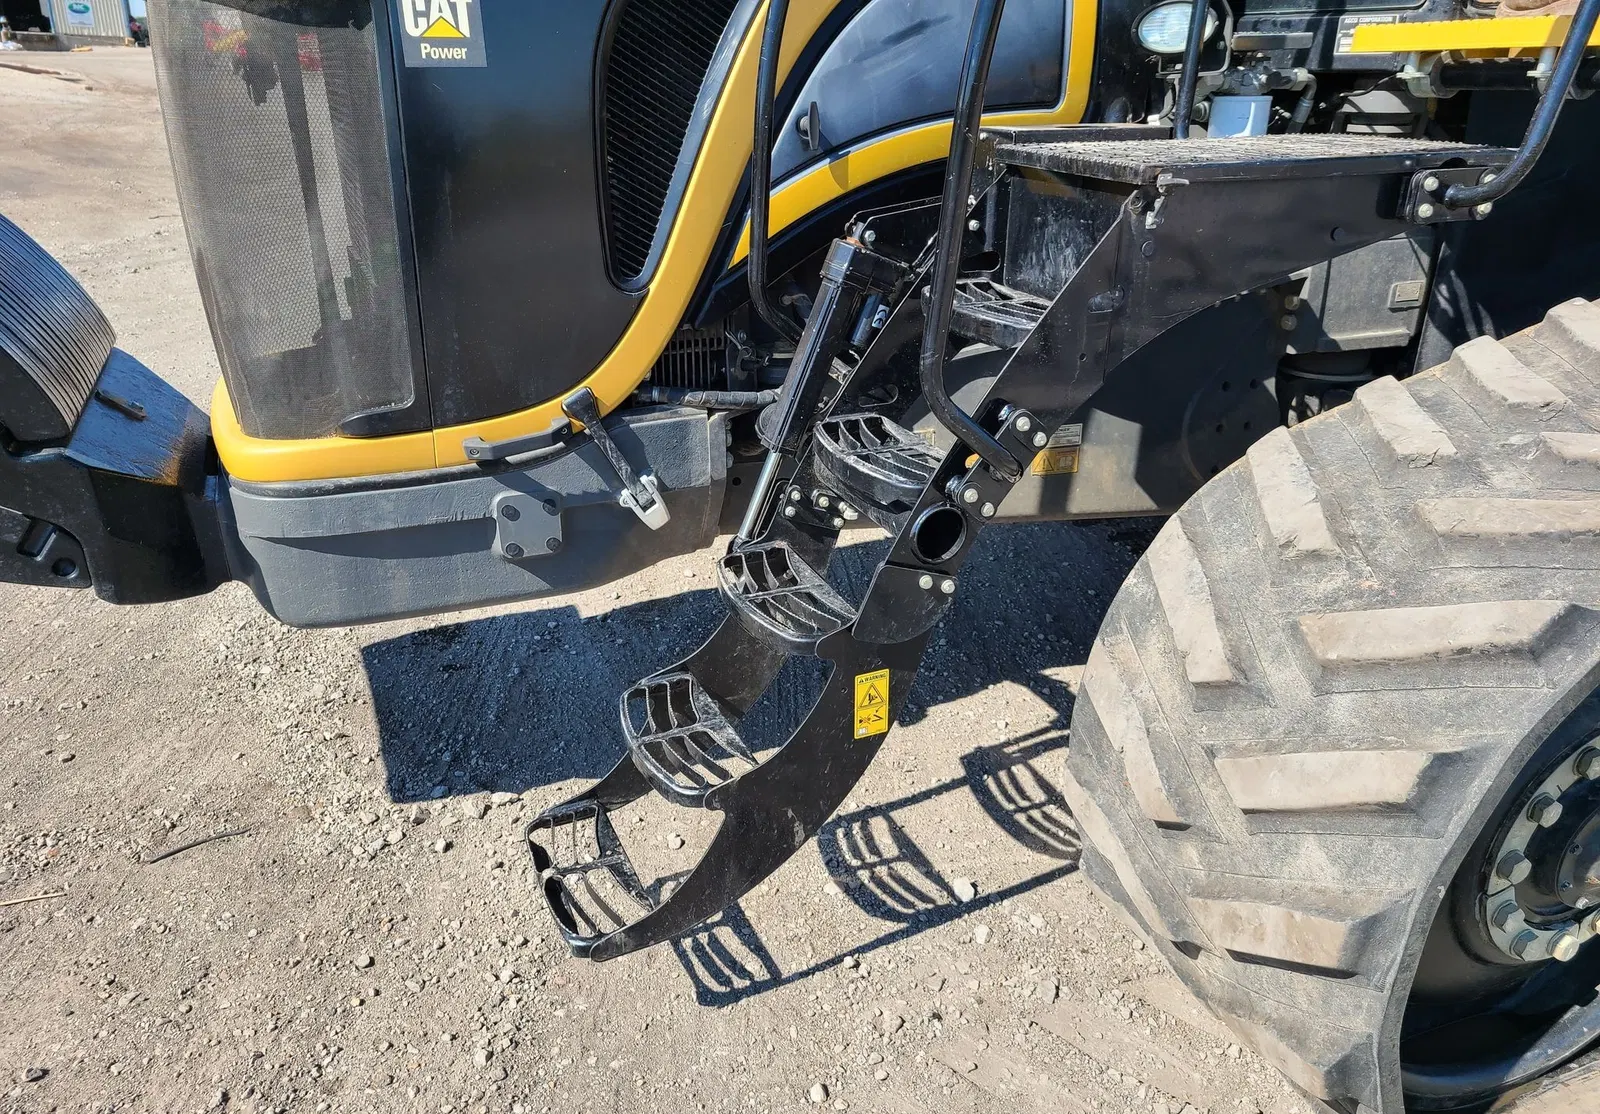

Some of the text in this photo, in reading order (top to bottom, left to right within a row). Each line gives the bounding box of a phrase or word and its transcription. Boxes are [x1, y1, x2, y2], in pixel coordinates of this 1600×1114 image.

[402, 0, 471, 37] CAT
[420, 43, 468, 60] Power
[864, 672, 886, 682] WARNING
